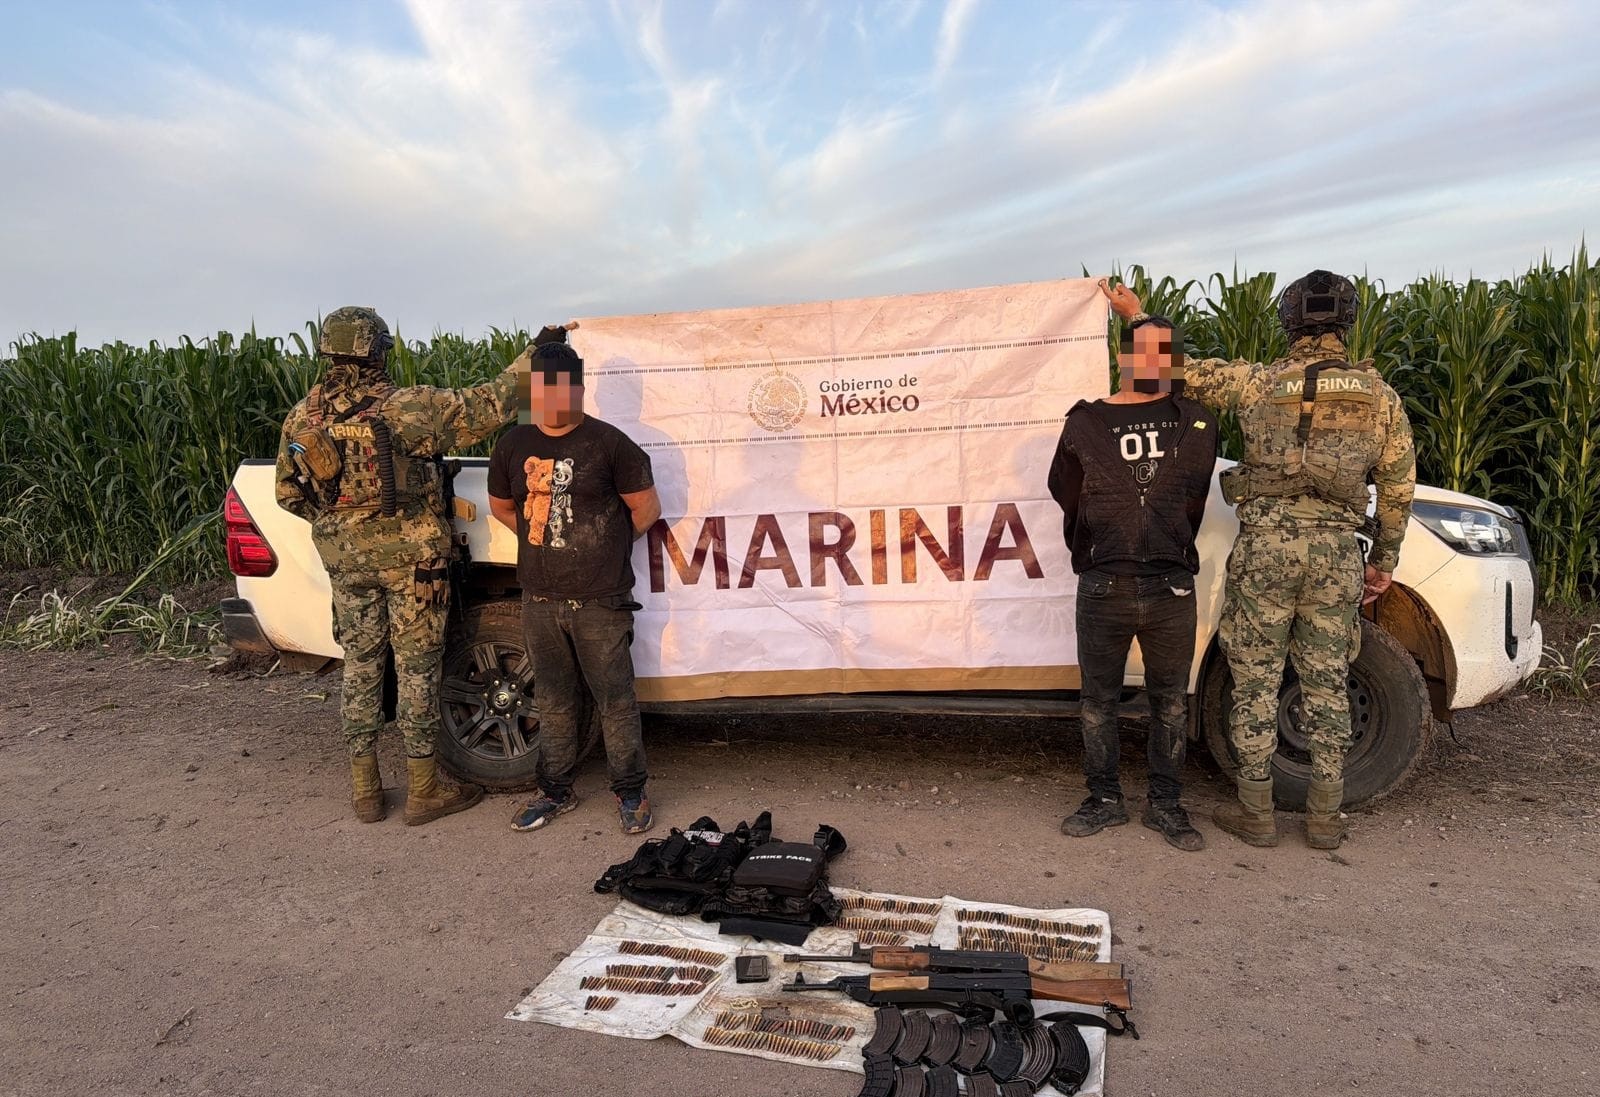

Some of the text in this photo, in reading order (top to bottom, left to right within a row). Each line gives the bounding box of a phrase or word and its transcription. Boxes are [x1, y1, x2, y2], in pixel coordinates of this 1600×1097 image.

[819, 374, 918, 392] Gobierno de
[1286, 377, 1362, 393] MRINA
[820, 390, 920, 418] México
[328, 425, 373, 438] ARINA
[1127, 422, 1155, 431] YORK
[1120, 431, 1165, 461] OL
[646, 502, 1045, 593] MARINA
